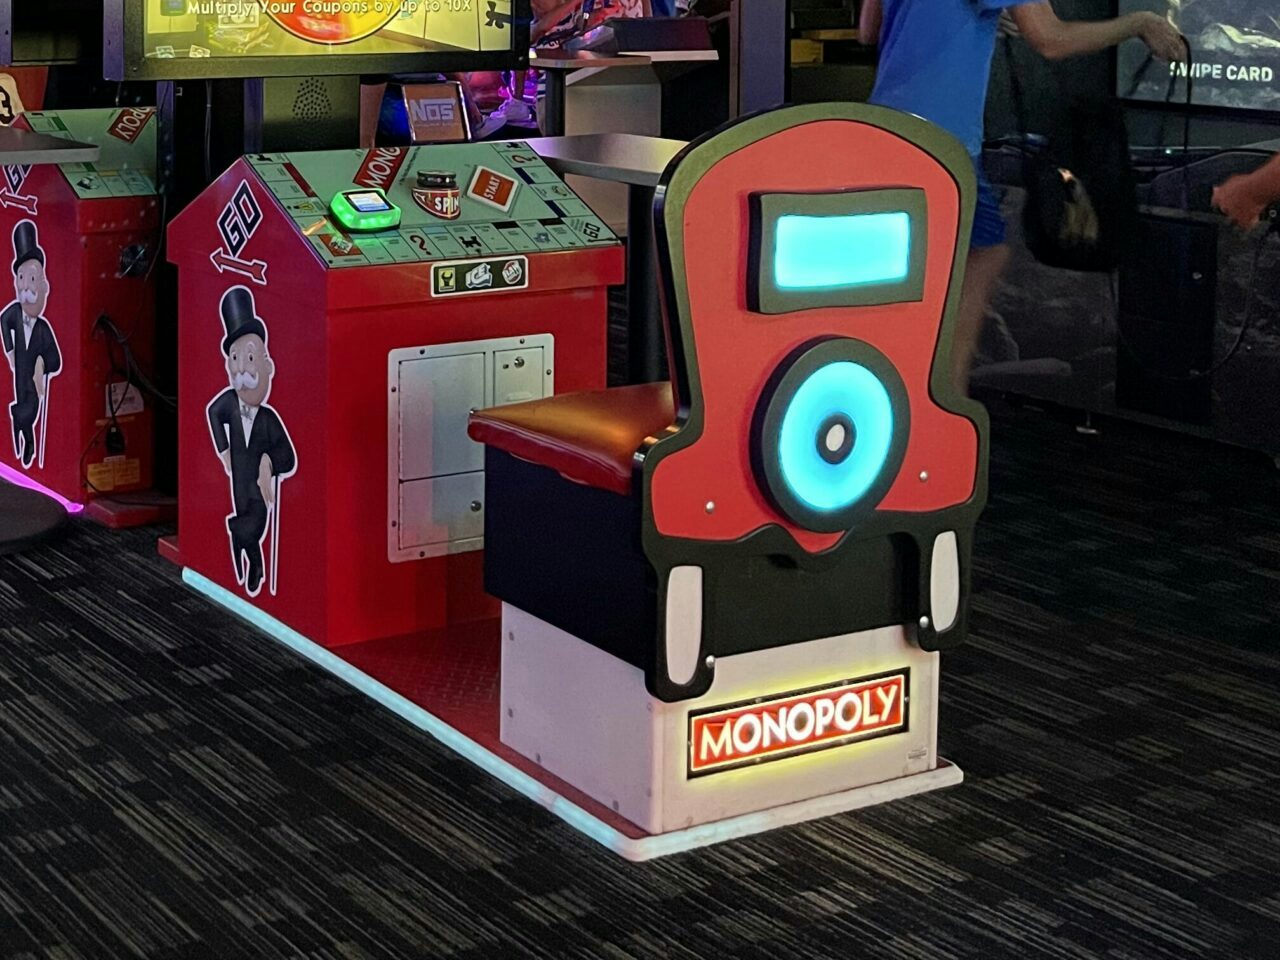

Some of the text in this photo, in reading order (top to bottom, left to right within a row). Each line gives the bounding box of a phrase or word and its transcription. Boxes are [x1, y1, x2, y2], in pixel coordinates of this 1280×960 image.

[187, 0, 253, 17] Multiply
[259, 0, 296, 14] Your
[302, 0, 369, 16] Coupons
[375, 0, 393, 15] by
[400, 0, 417, 15] up
[424, 0, 440, 12] to
[1169, 61, 1274, 82] SWIPE CARD
[410, 98, 457, 121] NOS
[483, 175, 502, 201] START
[434, 194, 459, 213] SPIN
[217, 179, 263, 259] GO
[699, 684, 898, 761] MONOPOLY
